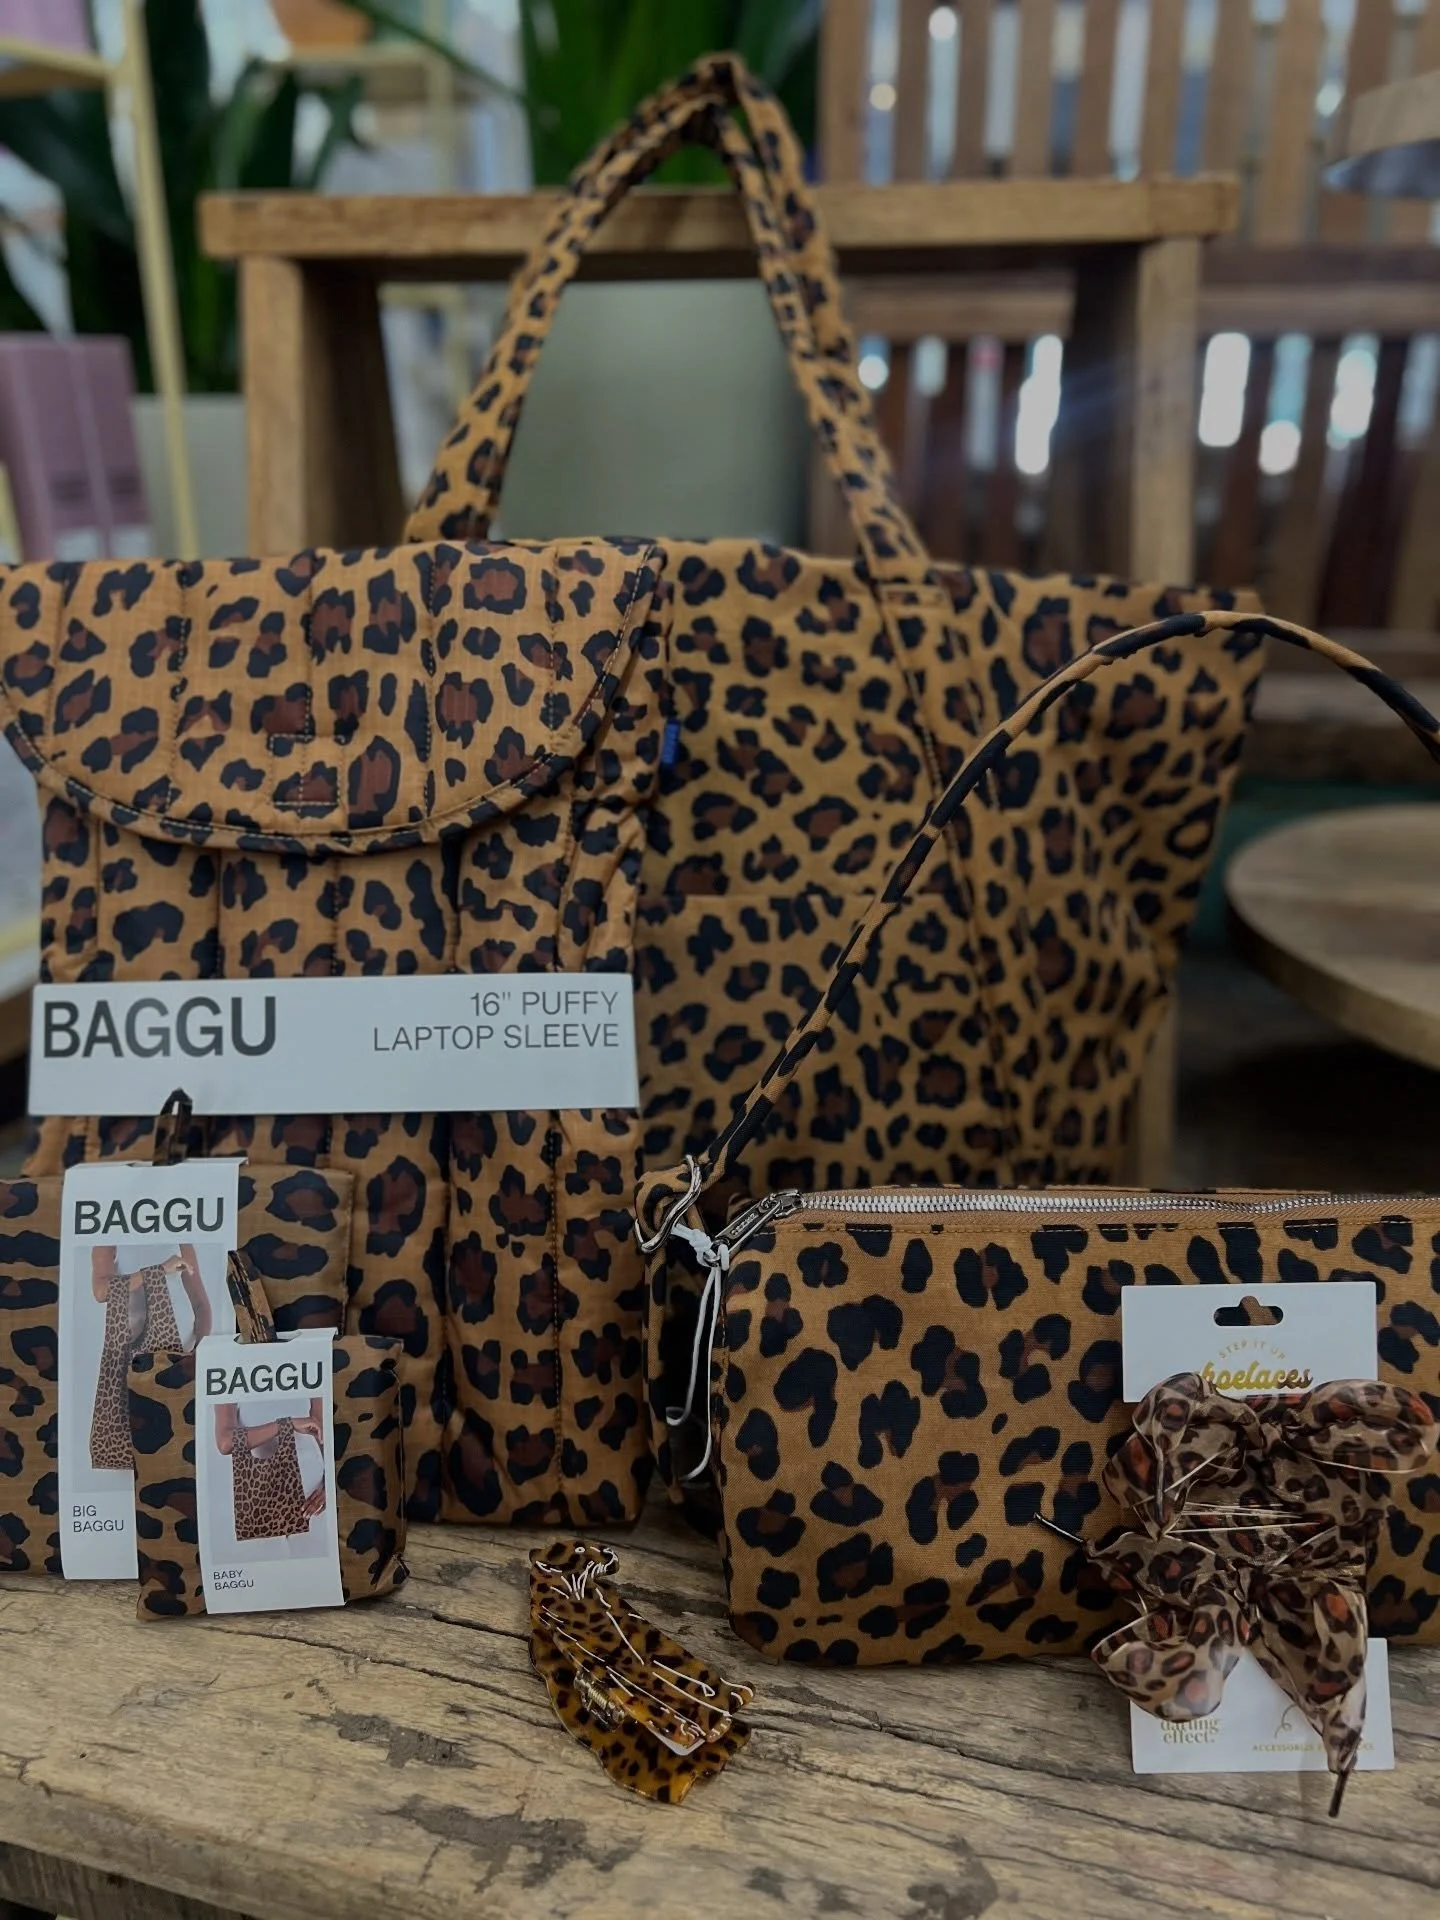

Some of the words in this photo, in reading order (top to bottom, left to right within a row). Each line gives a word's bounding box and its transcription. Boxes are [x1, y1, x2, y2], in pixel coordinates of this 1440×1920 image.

[471, 992, 511, 1017] 16"
[522, 990, 618, 1015] PUFFY
[43, 996, 277, 1059] BAGGU
[374, 1026, 494, 1052] LAPTOP
[503, 1023, 619, 1049] SLEEVE
[74, 1197, 225, 1235] BAGGU
[206, 1361, 324, 1396] BAGGU
[1201, 1360, 1314, 1390] hoelaces
[73, 1505, 97, 1517] BIG
[73, 1519, 125, 1533] BAGGU
[213, 1569, 243, 1581] BABY
[214, 1578, 255, 1591] BAGGU
